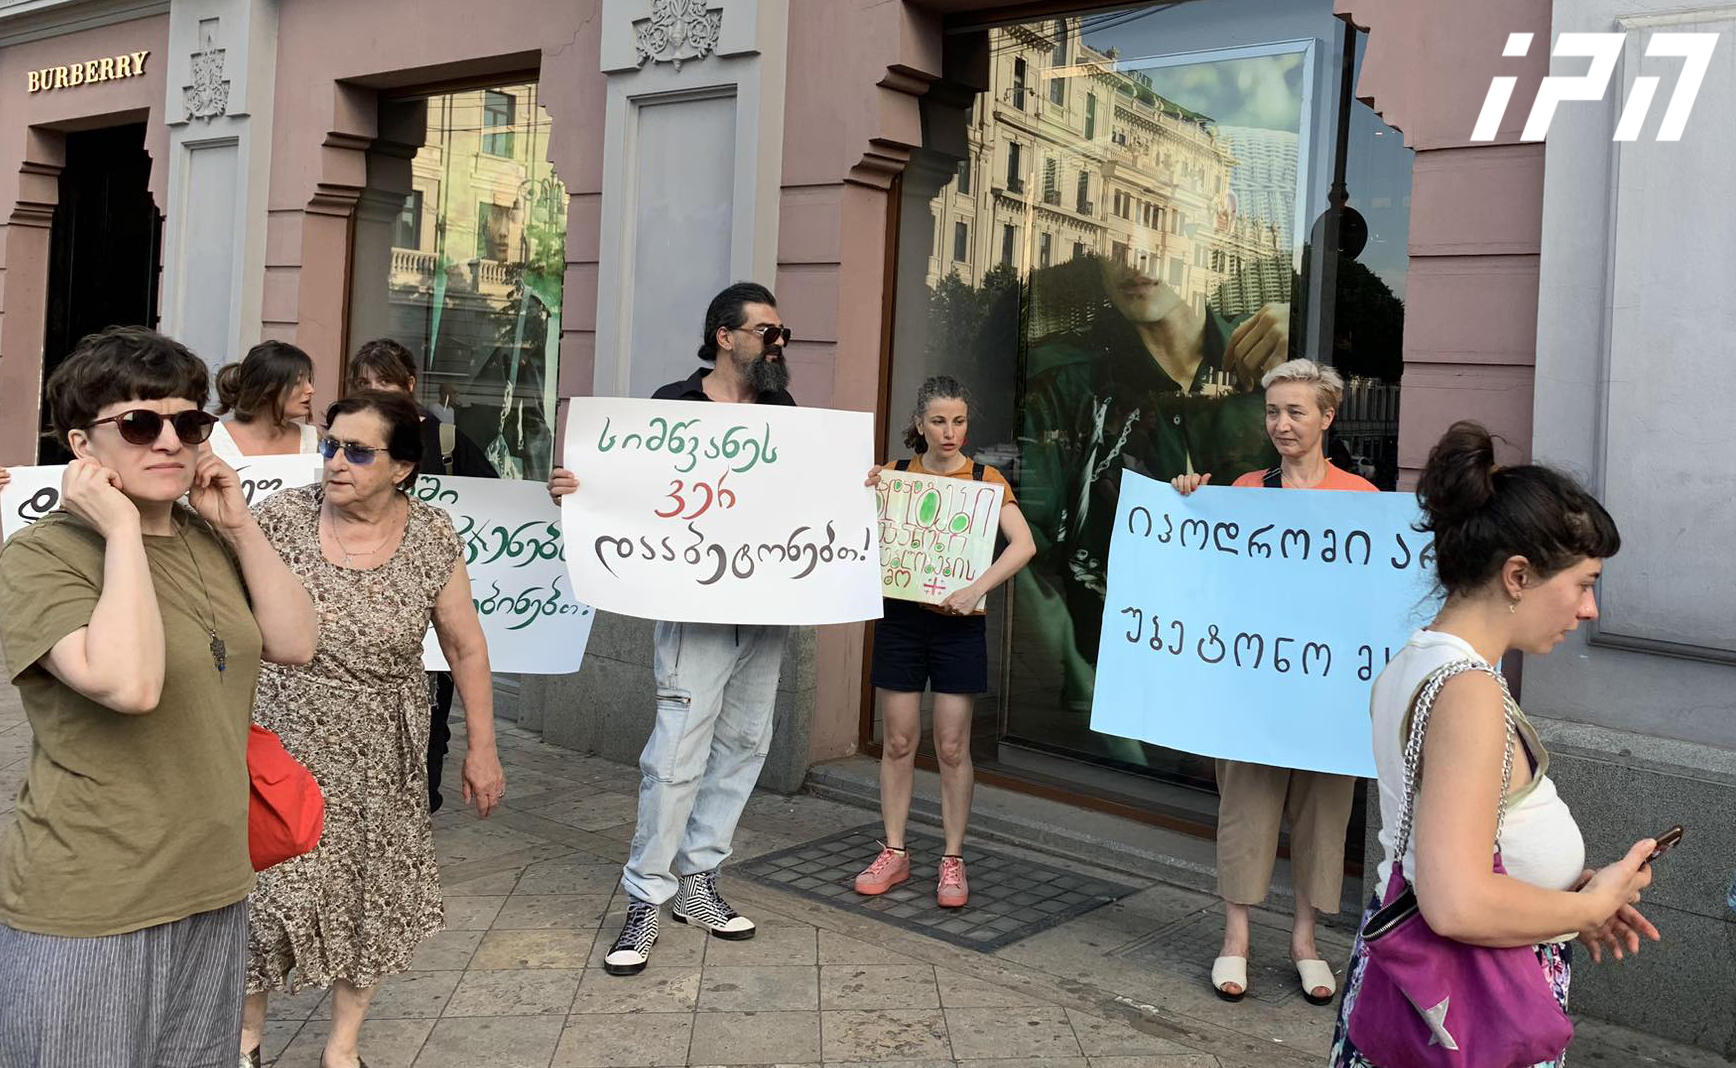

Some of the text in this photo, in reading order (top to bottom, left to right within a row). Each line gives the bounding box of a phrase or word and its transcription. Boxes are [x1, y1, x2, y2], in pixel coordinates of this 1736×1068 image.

[27, 50, 149, 93] BURBERRY
[598, 416, 778, 472] სიმწვანეს
[654, 466, 736, 520] ვერ
[594, 520, 871, 585] დააბეტონებთ!
[1128, 506, 1371, 566] იპოდრომი
